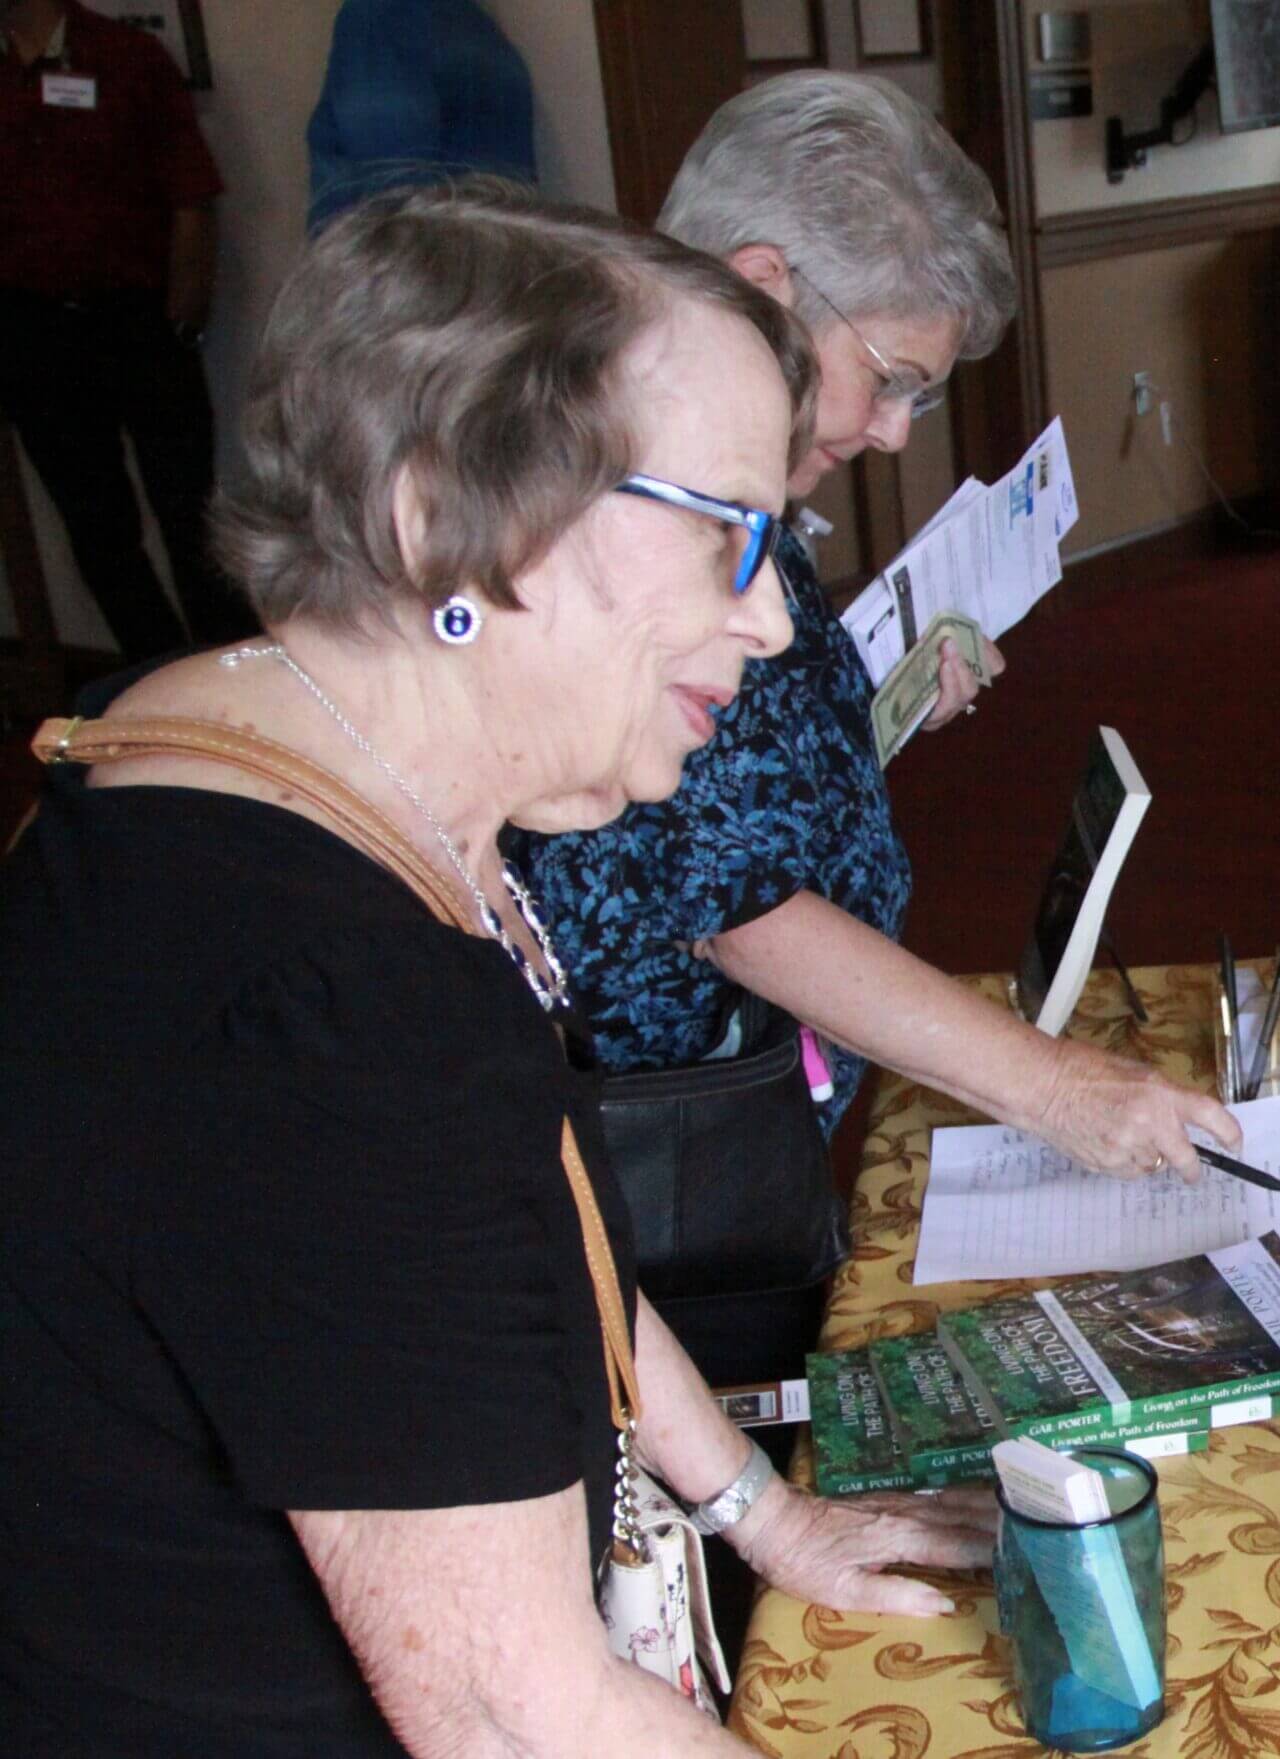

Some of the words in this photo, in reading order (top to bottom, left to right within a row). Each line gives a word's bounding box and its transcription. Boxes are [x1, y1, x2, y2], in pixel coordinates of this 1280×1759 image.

[1222, 1264, 1270, 1314] PORTER
[982, 1327, 1002, 1344] ON
[1001, 1325, 1022, 1338] OF
[927, 1352, 947, 1368] OF
[992, 1343, 1025, 1376] LIVING
[1012, 1338, 1041, 1364] PATH
[1023, 1316, 1097, 1396] FREEDOM
[906, 1354, 927, 1374] ON
[1029, 1362, 1054, 1384] THE
[836, 1374, 855, 1393] ON
[858, 1371, 876, 1388] OF
[912, 1373, 941, 1405] LIVING
[934, 1366, 958, 1396] PATH
[839, 1393, 859, 1427] LIVING
[862, 1388, 882, 1418] PATH
[945, 1394, 968, 1416] THE
[1143, 1400, 1175, 1415] Living
[1174, 1397, 1189, 1408] on
[1189, 1393, 1207, 1406] the
[1207, 1387, 1231, 1403] Path
[1231, 1384, 1244, 1397] of
[866, 1418, 885, 1439] THE
[1028, 1422, 1055, 1437] GAIL
[1057, 1413, 1102, 1430] PORTER
[1051, 1437, 1083, 1450] Living
[1081, 1433, 1099, 1444] on
[1099, 1429, 1117, 1441] the
[1118, 1425, 1142, 1438] Path
[1143, 1420, 1157, 1433] of
[1156, 1416, 1199, 1431] Freedom
[931, 1454, 956, 1468] GAIL
[838, 1479, 864, 1494] GAIL
[868, 1475, 915, 1489] PORTER
